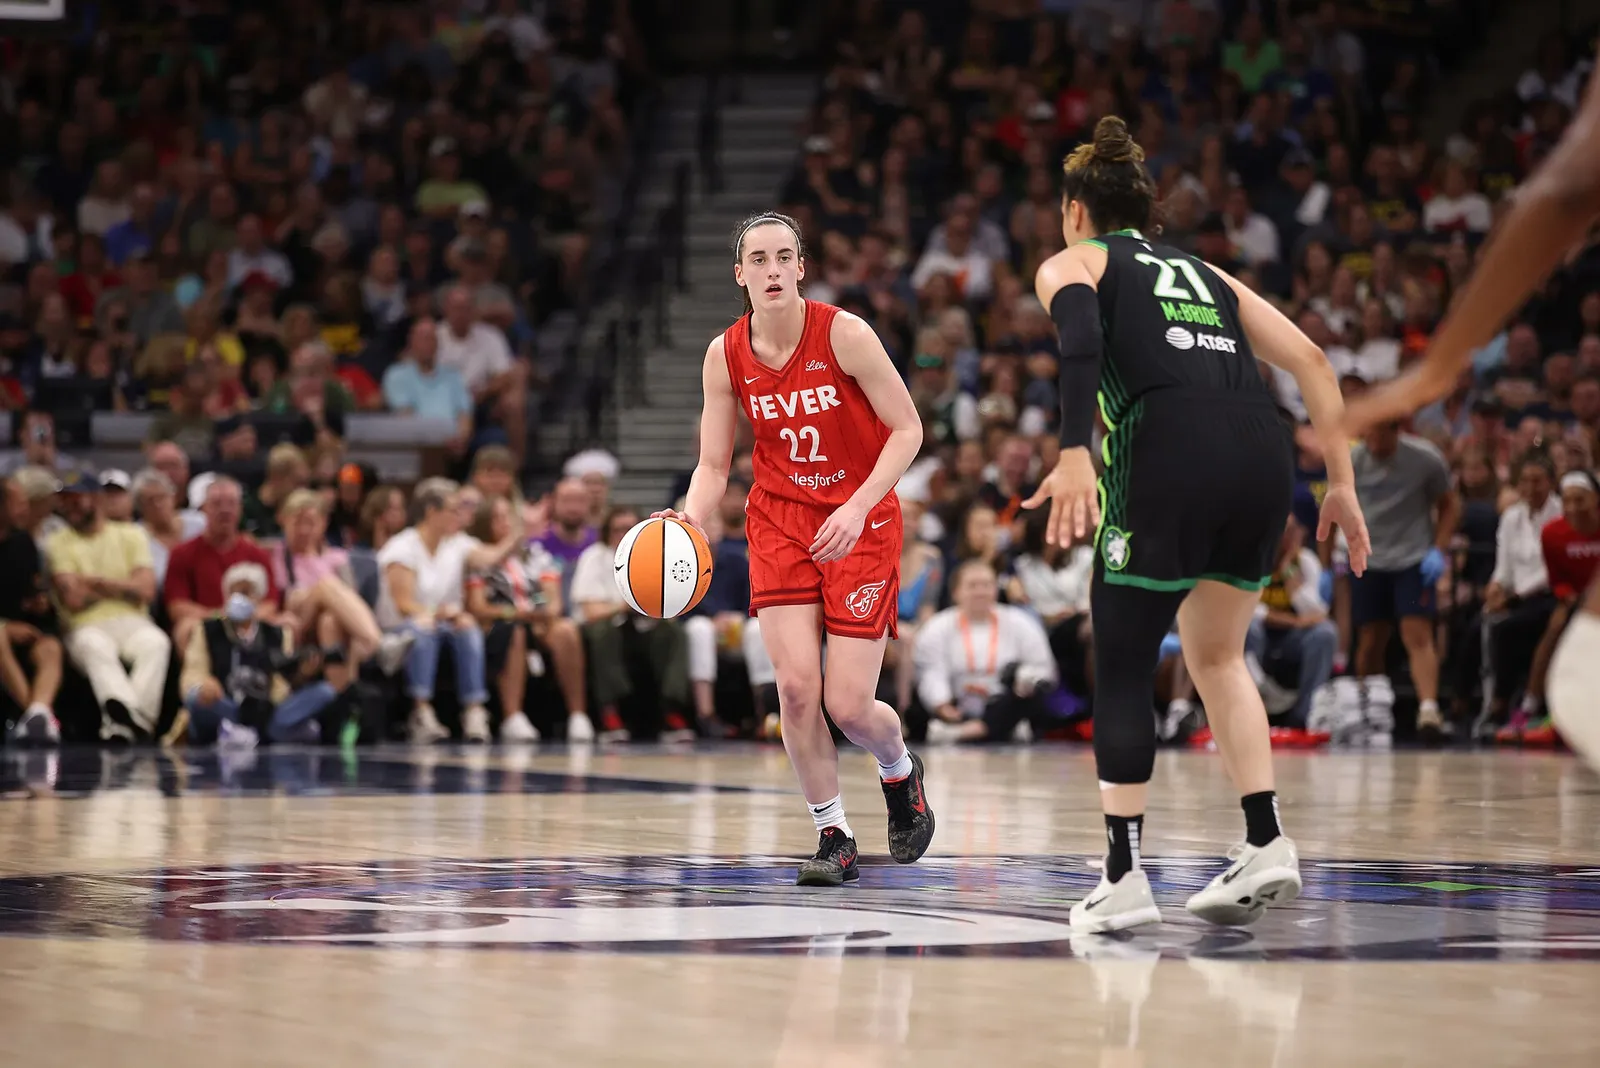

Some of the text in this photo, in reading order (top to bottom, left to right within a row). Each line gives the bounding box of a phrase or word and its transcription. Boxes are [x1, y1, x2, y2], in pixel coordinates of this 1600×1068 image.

[1134, 252, 1215, 305] 21
[1197, 332, 1237, 354] AT&T
[805, 359, 828, 371] Lilly
[749, 384, 842, 420] FEVER
[779, 425, 828, 463] 22
